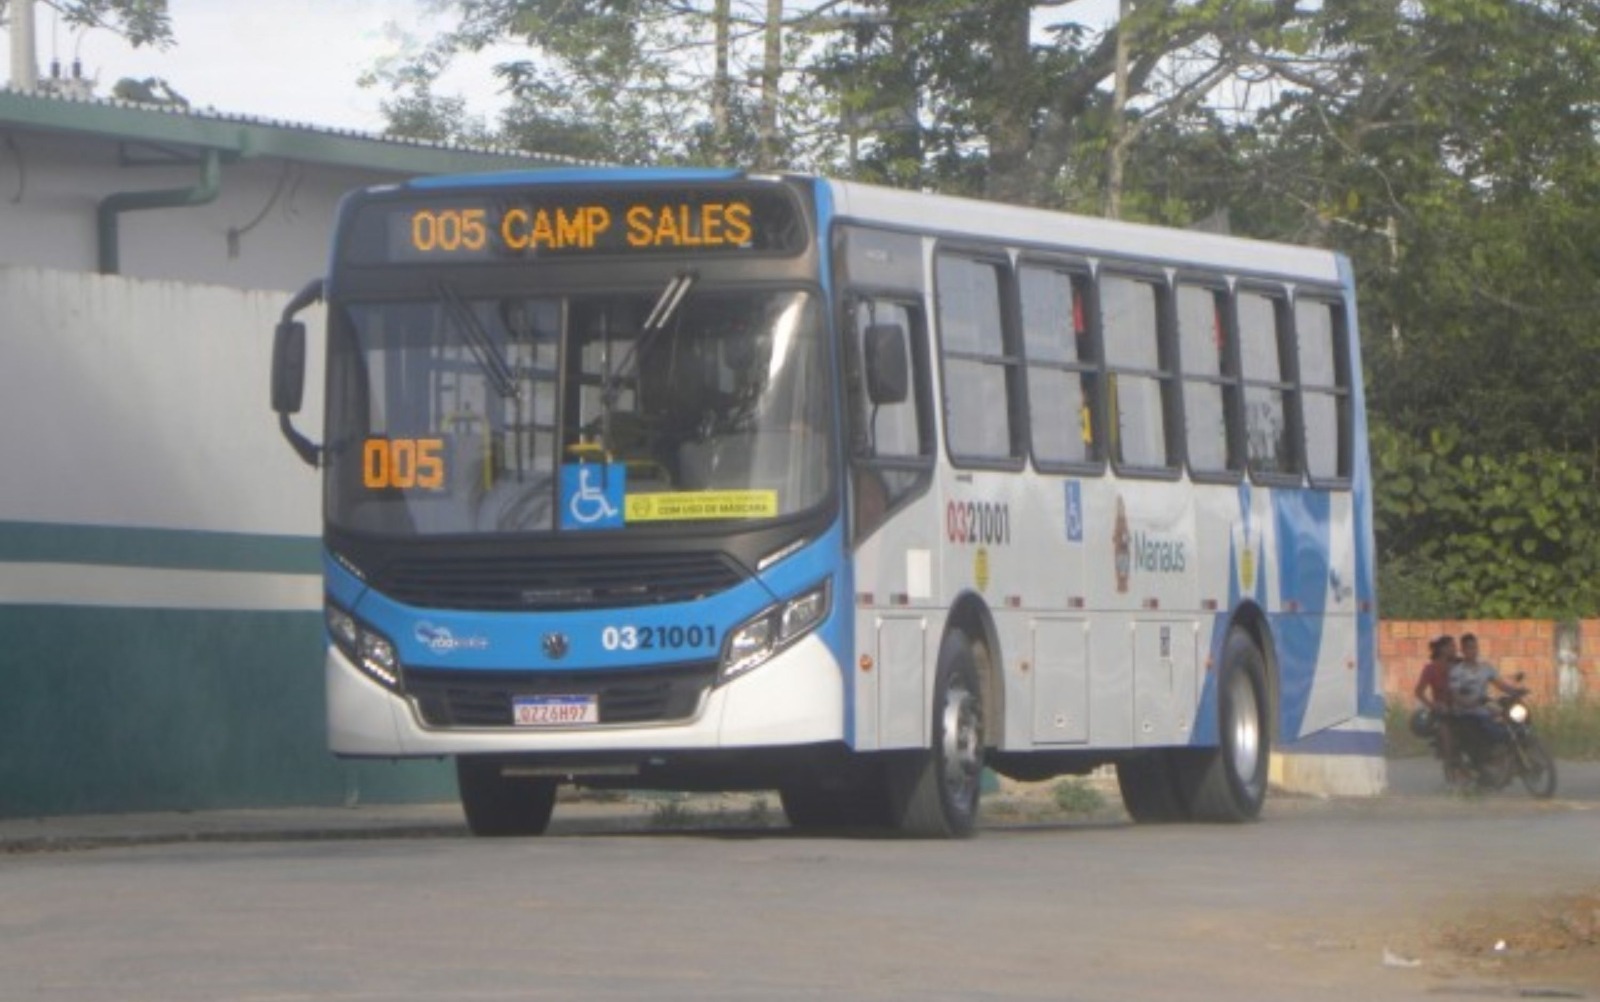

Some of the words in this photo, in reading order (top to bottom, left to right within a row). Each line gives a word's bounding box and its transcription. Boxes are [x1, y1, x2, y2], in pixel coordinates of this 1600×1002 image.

[411, 209, 487, 251] 005
[502, 206, 611, 249] CAMP
[625, 202, 753, 247] SALES
[362, 437, 445, 490] 005
[657, 505, 681, 515] COM
[704, 503, 717, 514] DE
[946, 500, 1011, 546] 0321001
[1133, 530, 1186, 573] Manaus
[601, 623, 717, 651] 0321001
